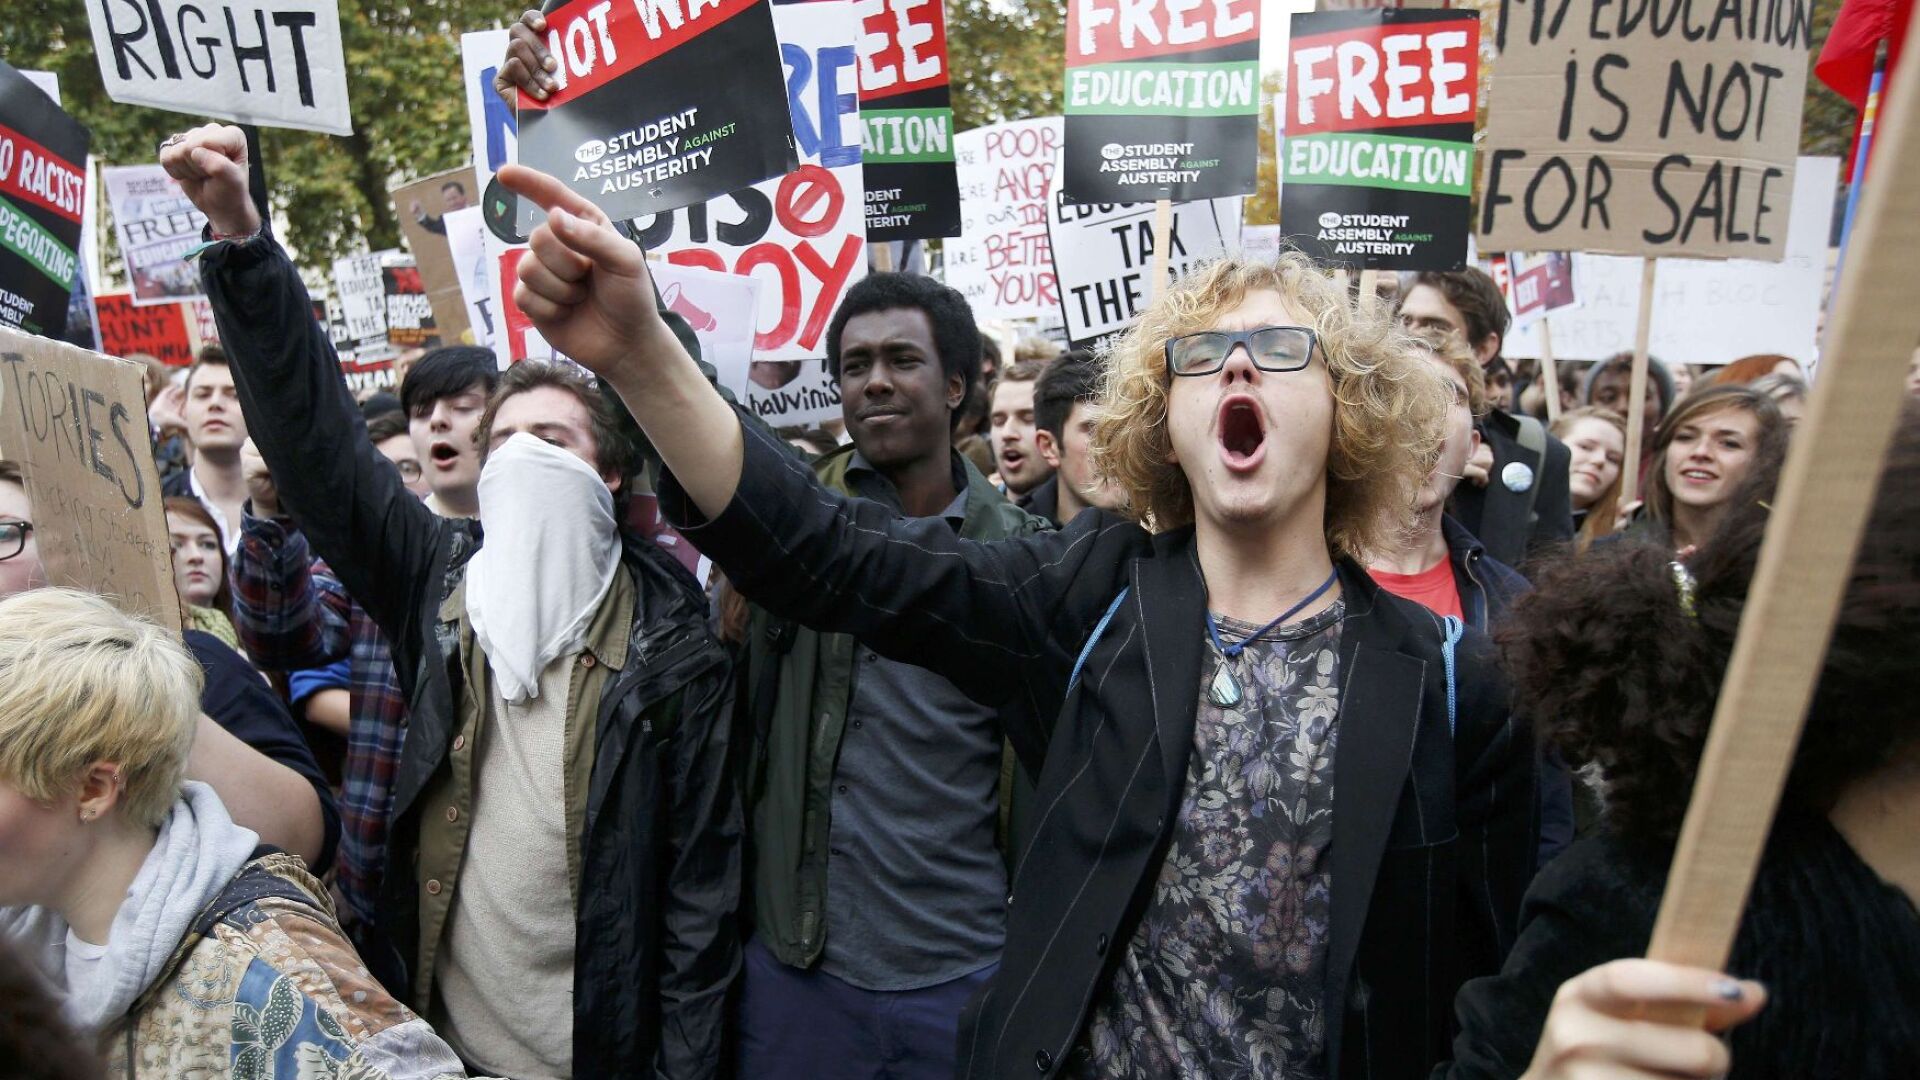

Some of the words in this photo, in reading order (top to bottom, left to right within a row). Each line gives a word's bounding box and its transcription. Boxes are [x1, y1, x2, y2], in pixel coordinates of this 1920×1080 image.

[1078, 0, 1254, 55] FREE
[1588, 0, 1815, 50] EDUCATION
[103, 0, 316, 108] RIGHT
[1294, 31, 1470, 124] FREE
[1071, 69, 1254, 108] EDUCATION
[1658, 59, 1784, 142] NOT
[573, 137, 680, 182] ASSEMBLY
[683, 122, 737, 151] AGAINST
[579, 145, 603, 159] THE
[608, 108, 698, 153] STUDENT
[986, 127, 1064, 162] POOR
[1124, 143, 1195, 157] STUDENT
[18, 149, 84, 216] RACIST
[600, 147, 713, 195] AUSTERITY
[1100, 157, 1178, 172] ASSEMBLY
[1180, 159, 1220, 169] AGAINST
[1117, 170, 1201, 185] AUSTERITY
[1288, 139, 1468, 187] EDUCATION
[891, 204, 928, 214] AGAINST
[1481, 149, 1613, 235] FOR
[1642, 154, 1784, 244] SALE
[122, 209, 206, 244] FREE
[865, 213, 911, 229] TERITY
[1317, 229, 1394, 242] ASSEMBLY
[1394, 233, 1434, 243] AGAINST
[1341, 214, 1410, 228] STUDENT
[1334, 243, 1415, 256] AUSTERITY
[1, 351, 145, 509] TORIES
